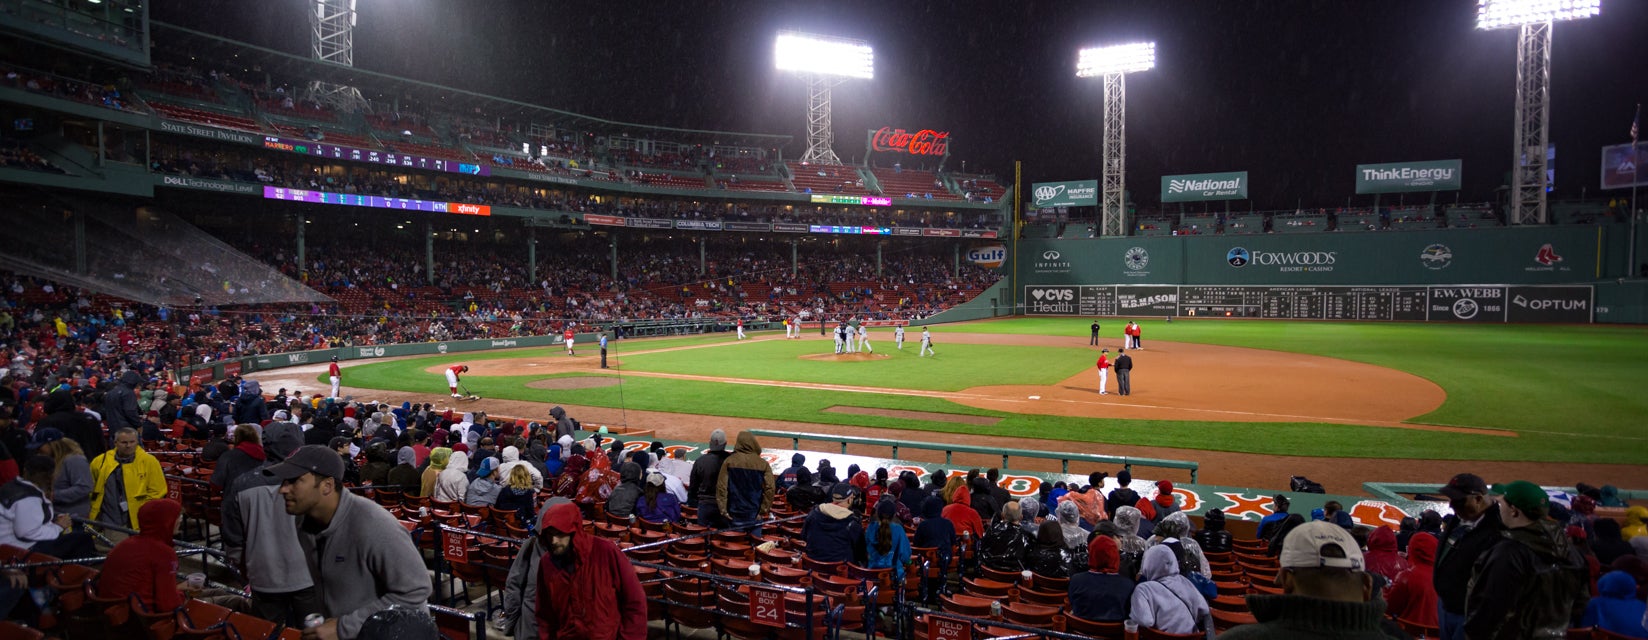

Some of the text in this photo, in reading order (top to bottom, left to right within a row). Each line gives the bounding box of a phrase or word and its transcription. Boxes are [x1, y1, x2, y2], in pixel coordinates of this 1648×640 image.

[161, 122, 253, 144] STATE STREET PAVILION
[164, 176, 253, 193] DELL Technologies Level
[1184, 178, 1240, 191] National
[1038, 187, 1054, 196] AAA
[458, 205, 480, 214] xfinity
[969, 250, 1004, 260] Gulf
[1252, 250, 1336, 265] FOXWOODS
[1045, 289, 1073, 301] CVS
[1434, 288, 1501, 298] F.W. WEBB
[1033, 301, 1074, 313] Health
[1530, 299, 1586, 310] OPTUM
[448, 545, 464, 557] 25
[755, 590, 778, 599] FIELD
[758, 597, 774, 606] BOX
[756, 605, 778, 620] 24
[936, 620, 963, 630] FIELD
[939, 628, 958, 637] BOX
